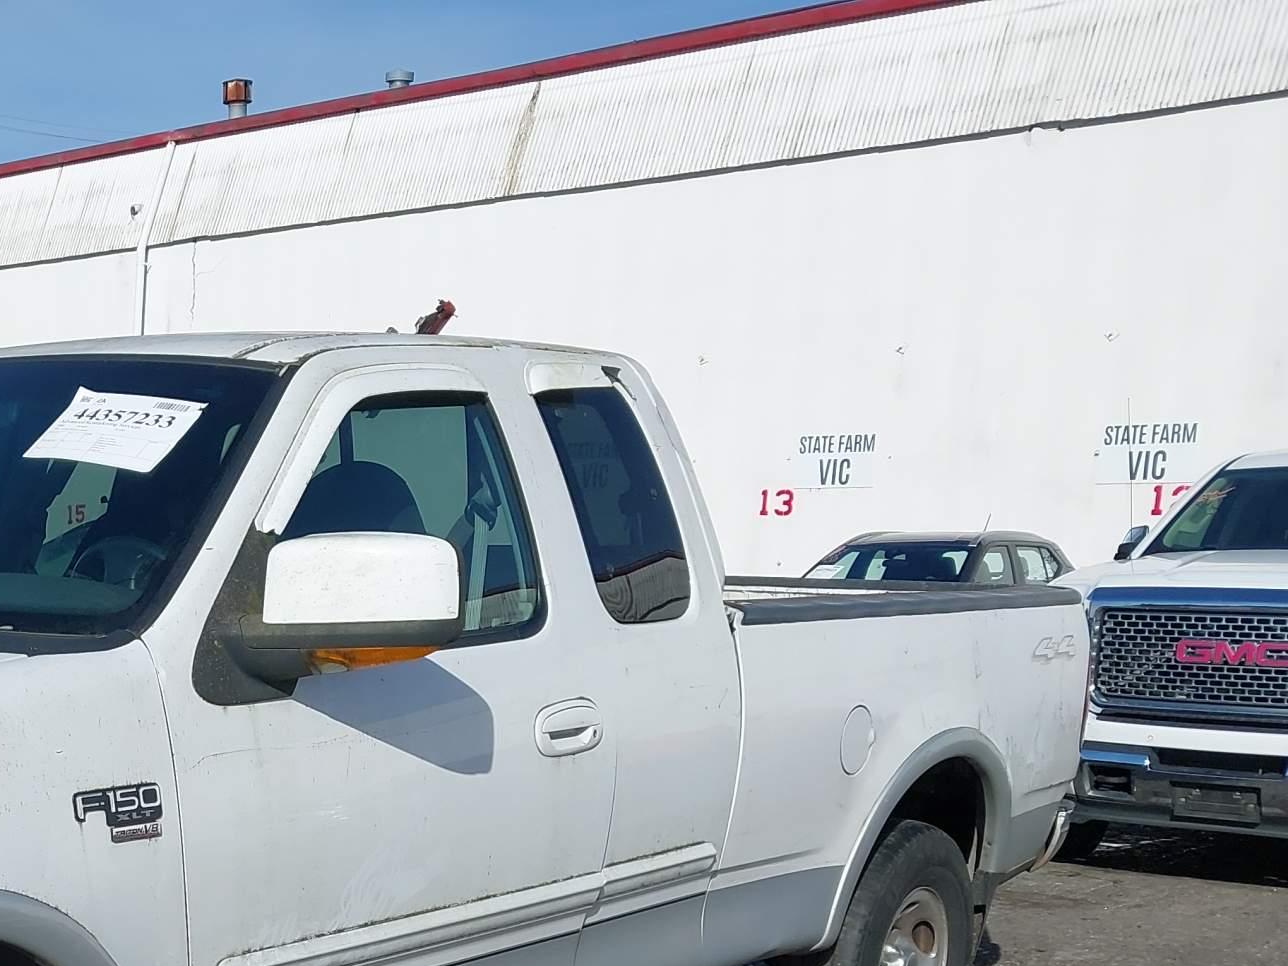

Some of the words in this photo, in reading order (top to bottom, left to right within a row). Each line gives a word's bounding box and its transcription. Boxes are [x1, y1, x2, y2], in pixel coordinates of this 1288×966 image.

[74, 408, 176, 429] 44357233
[799, 436, 835, 454] STATE
[838, 434, 876, 453] FARM
[1103, 425, 1147, 445] STATE
[1151, 423, 1199, 444] FARM
[819, 458, 851, 485] VIC
[1129, 450, 1167, 480] VIC
[759, 489, 794, 516] 13
[67, 504, 87, 525] 15
[1175, 639, 1288, 667] GMC
[75, 785, 161, 820] F-150
[115, 809, 156, 822] XLT
[144, 823, 159, 835] V8
